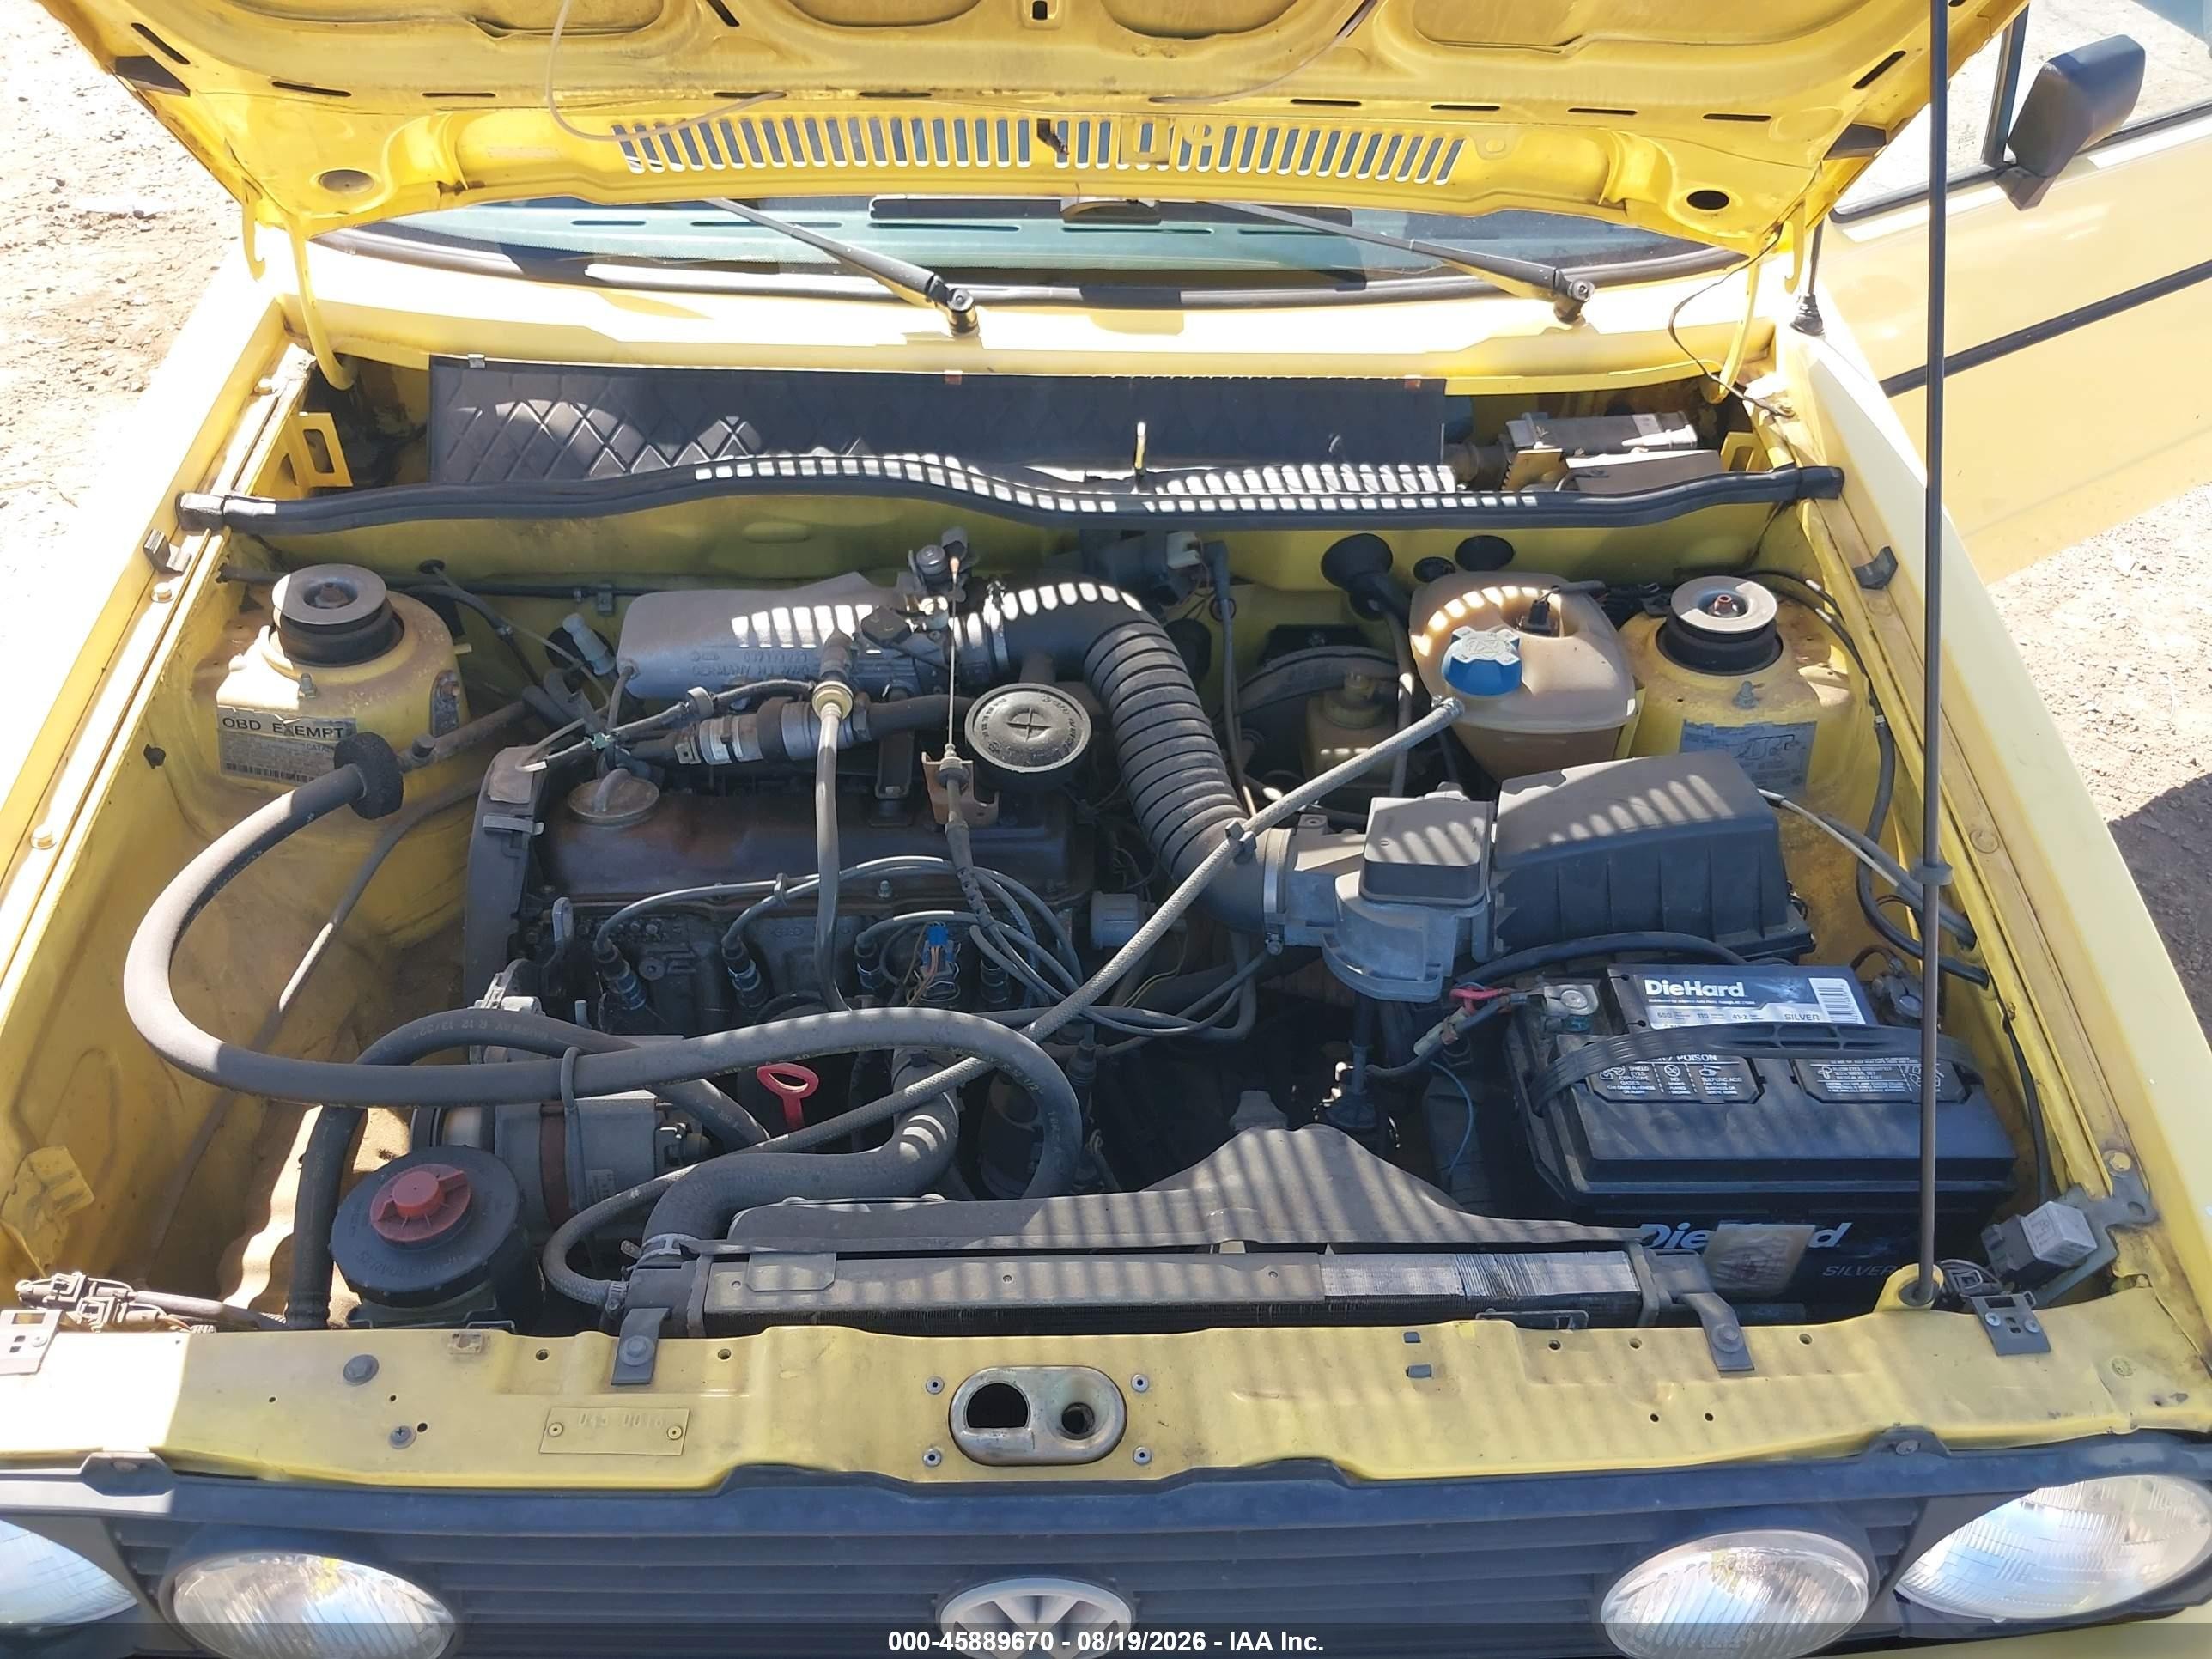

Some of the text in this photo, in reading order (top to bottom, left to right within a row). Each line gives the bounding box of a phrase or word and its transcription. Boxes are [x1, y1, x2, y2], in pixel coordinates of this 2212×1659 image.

[222, 717, 262, 731] OBD
[1644, 979, 1745, 998] DieHard
[1641, 1222, 1852, 1248] Died
[1822, 1265, 1899, 1276] SILVER
